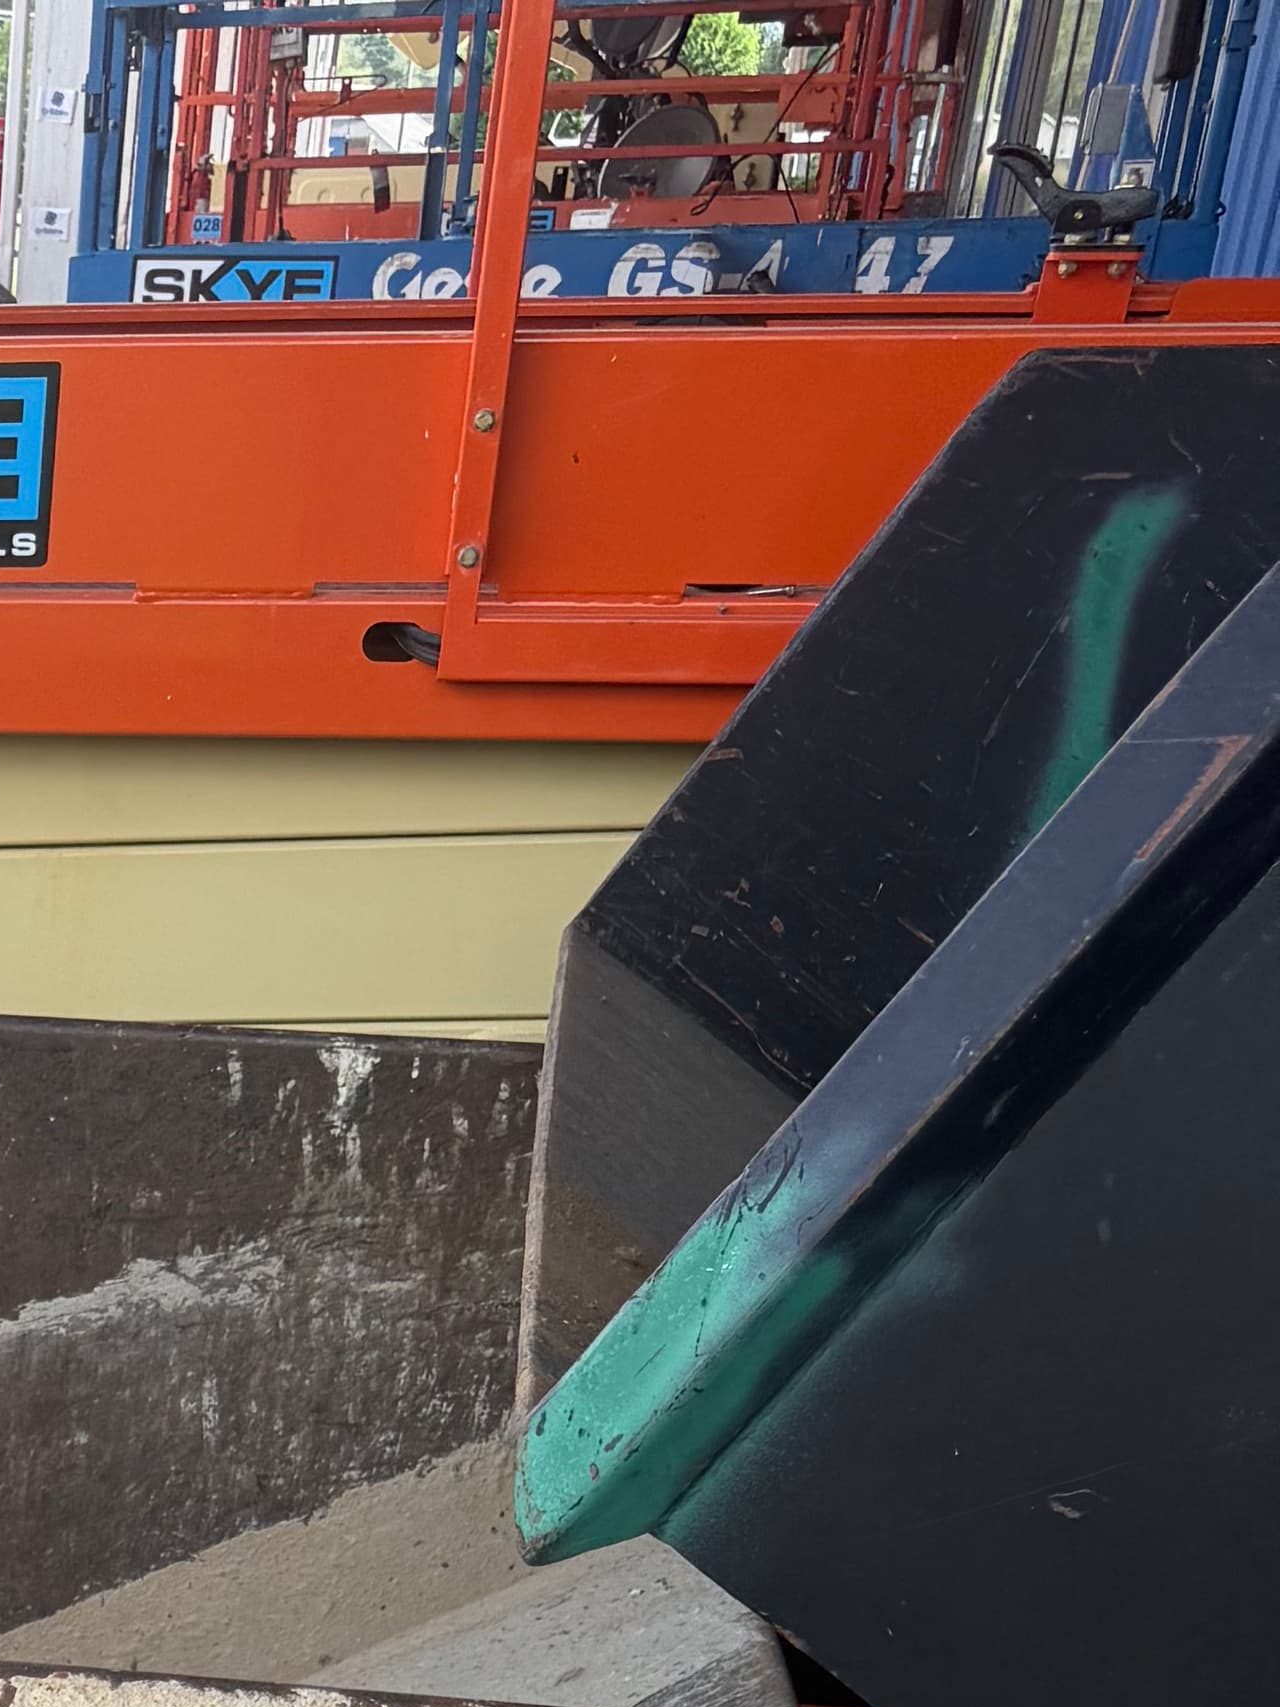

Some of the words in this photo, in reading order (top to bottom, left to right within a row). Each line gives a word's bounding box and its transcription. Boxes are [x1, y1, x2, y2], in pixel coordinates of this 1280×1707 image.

[142, 266, 326, 302] SKYE
[371, 252, 563, 300] Gee
[607, 235, 955, 298] GS-447
